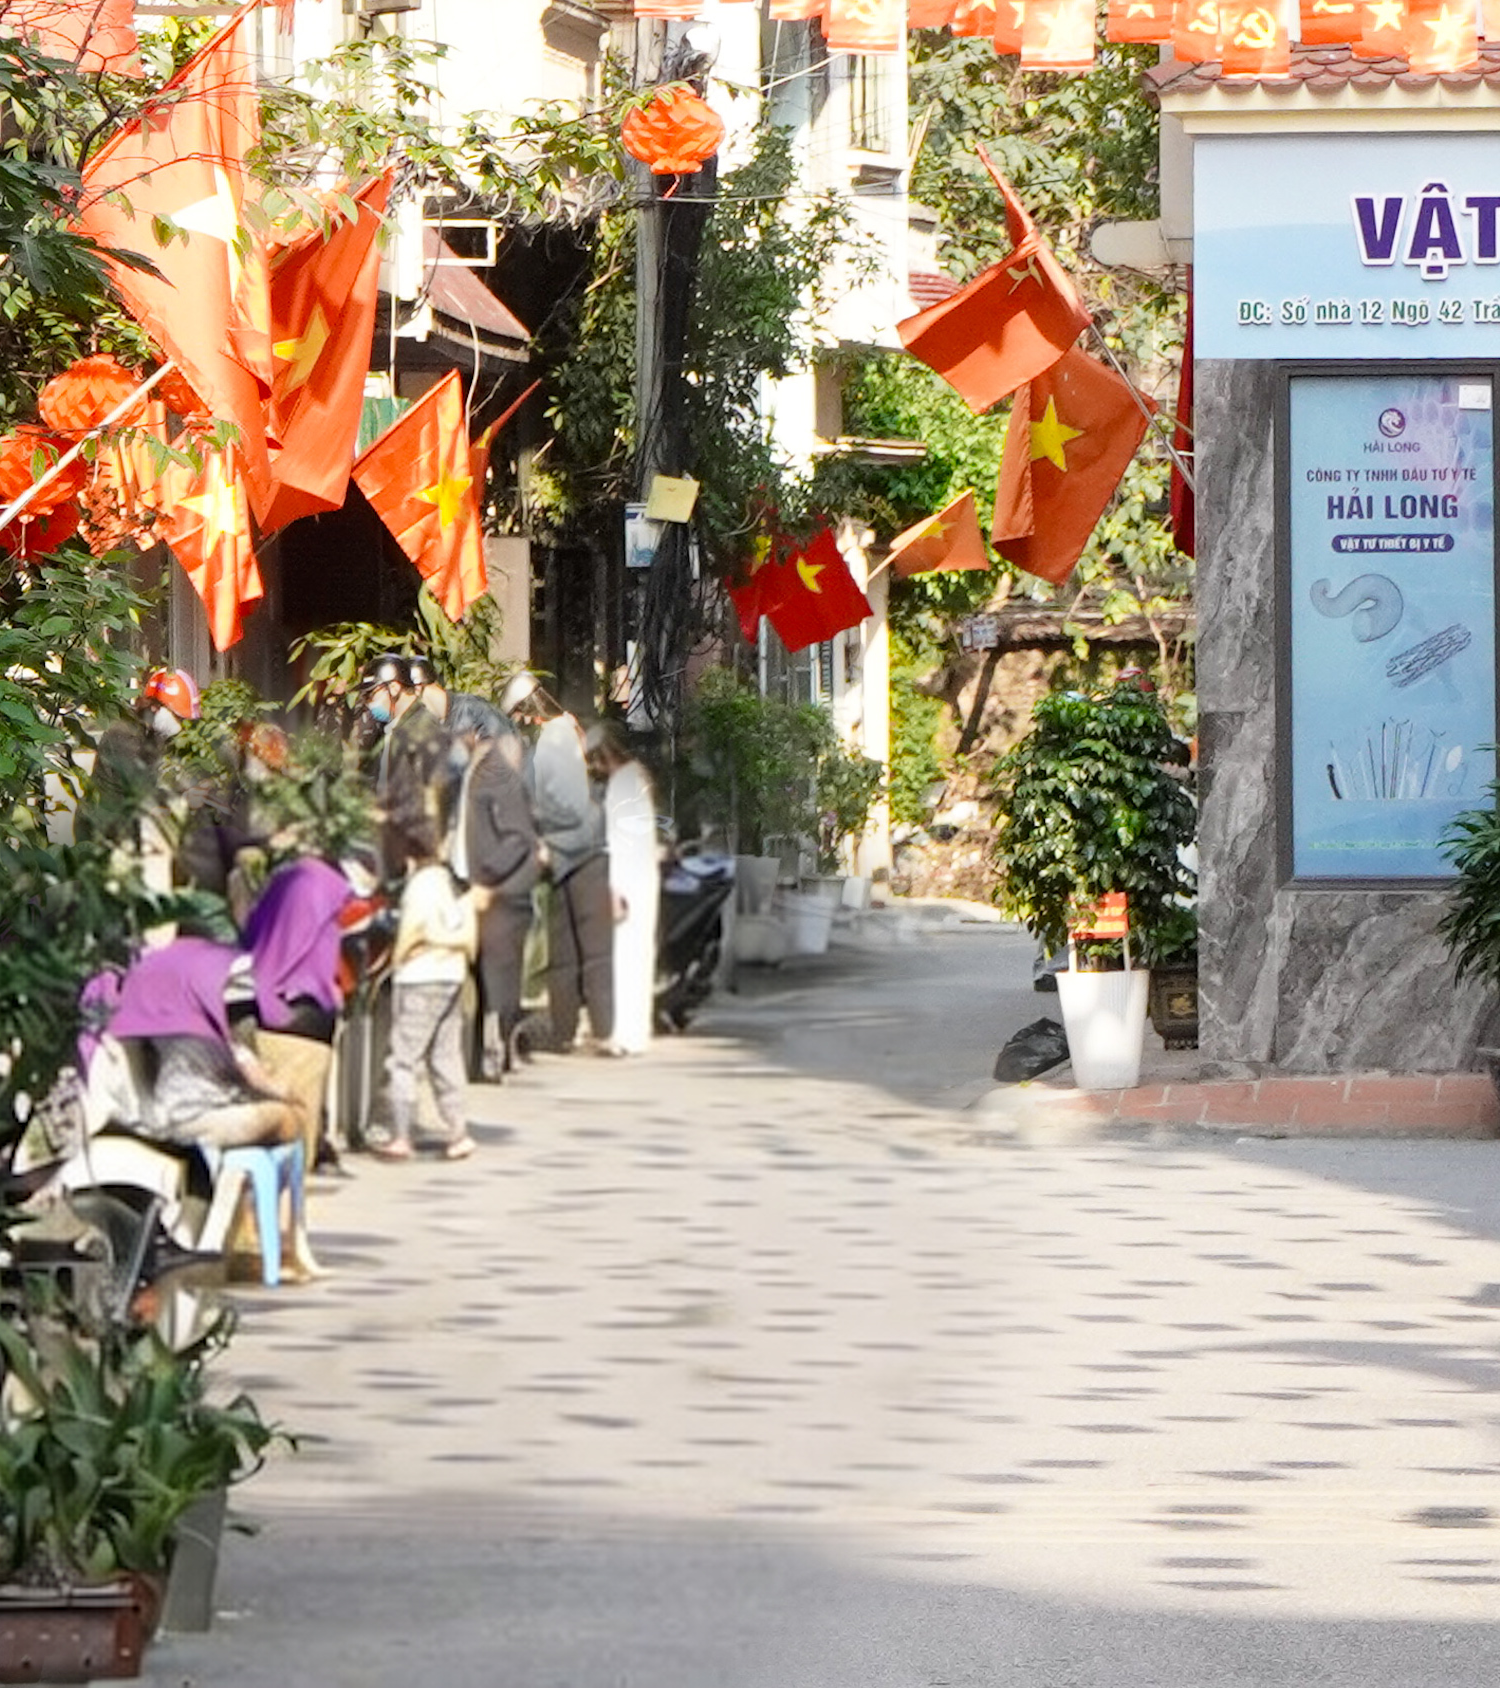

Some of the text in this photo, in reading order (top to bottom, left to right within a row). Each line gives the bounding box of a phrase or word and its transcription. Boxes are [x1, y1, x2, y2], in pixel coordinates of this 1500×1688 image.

[1281, 297, 1310, 324] Số
[1316, 296, 1352, 322] nhà
[1357, 300, 1382, 323] 12
[1392, 299, 1430, 326] Ngõ
[1437, 300, 1463, 323] 42
[1363, 440, 1421, 453] HẢI LONG
[1306, 466, 1342, 483] CÔNG
[1345, 469, 1361, 483] TY
[1364, 469, 1398, 482] TNHH
[1326, 486, 1459, 520] HẢI LONG
